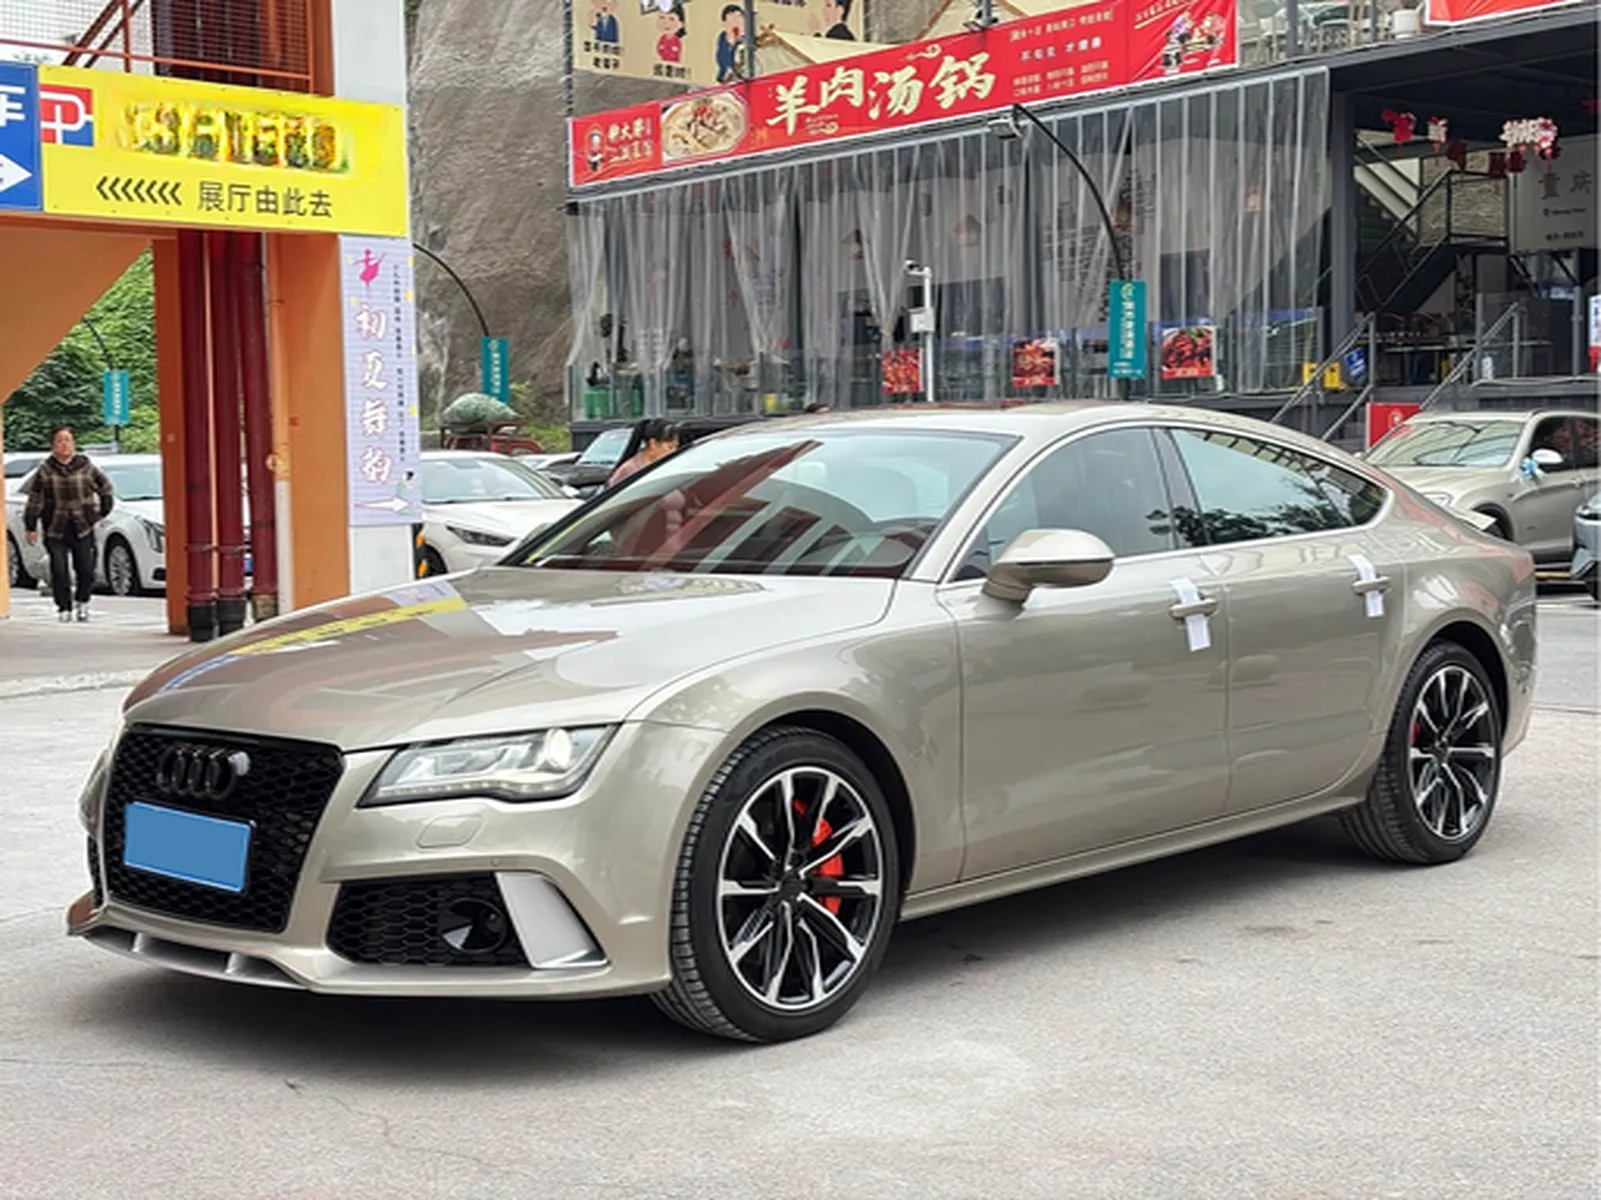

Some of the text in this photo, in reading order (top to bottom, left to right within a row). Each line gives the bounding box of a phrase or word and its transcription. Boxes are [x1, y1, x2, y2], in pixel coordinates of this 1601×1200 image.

[767, 53, 997, 136] 羊肉汤锅
[198, 180, 333, 219] 展厅由此去
